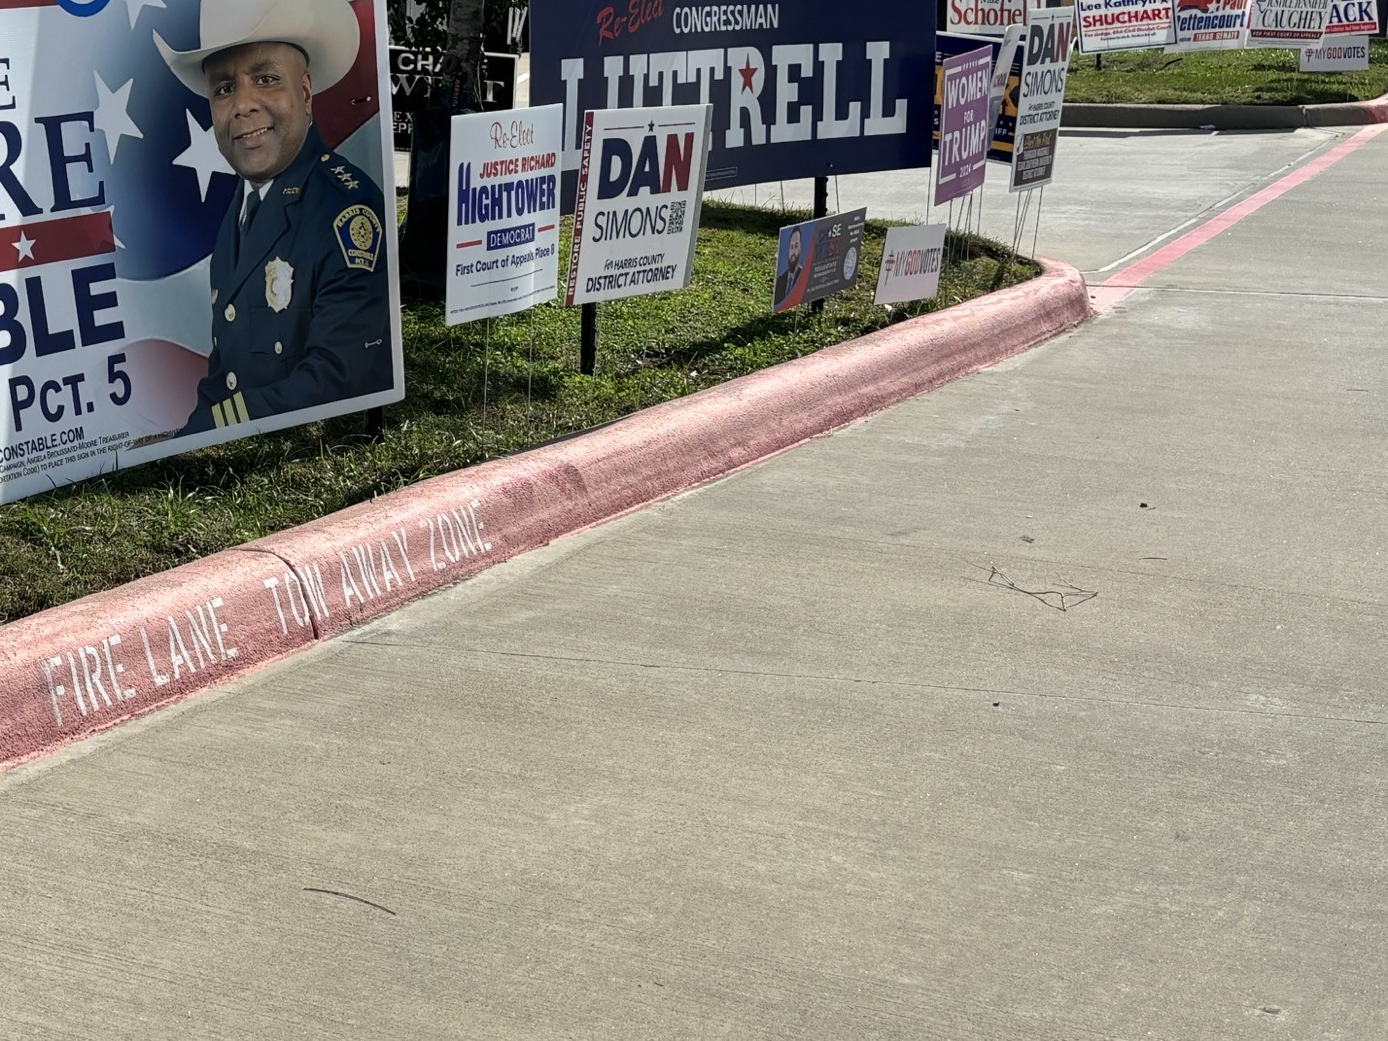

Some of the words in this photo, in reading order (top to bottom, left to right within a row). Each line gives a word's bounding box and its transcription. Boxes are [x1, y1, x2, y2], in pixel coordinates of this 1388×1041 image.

[673, 3, 779, 34] CONGRESSMAN
[1080, 1, 1102, 12] Lee
[1082, 7, 1172, 28] SHUCHART
[1261, 9, 1328, 30] CAUGHEY
[1328, 1, 1375, 24] ACK
[1026, 22, 1071, 67] DAN
[1315, 46, 1366, 59] MYGODVOTES
[948, 68, 989, 109] WOMEN
[1023, 67, 1065, 98] SIMONS
[561, 41, 908, 159] LUTTRELL
[964, 110, 973, 125] FOR
[490, 120, 534, 150] Re-Elect
[944, 119, 987, 167] TRUMP
[480, 158, 518, 180] JUSTICE
[520, 152, 557, 172] RICHARD
[597, 132, 695, 200] DAN
[457, 162, 557, 227] HIGHTOWER
[568, 231, 581, 297] RESTORE
[576, 181, 587, 230] PUBLIC
[582, 124, 593, 177] SAFETY
[592, 204, 669, 243] SIMONS
[490, 226, 534, 248] DEMOCRAT
[455, 262, 474, 277] First
[475, 257, 500, 272] Court
[500, 255, 509, 268] of
[535, 244, 550, 259] Place
[614, 257, 638, 271] HARRIS
[638, 253, 666, 268] COUNTY
[893, 247, 941, 277] MYGODVOTES
[586, 271, 630, 293] DISTRICT
[628, 264, 678, 287] ATTORNEY
[109, 354, 133, 407] 5
[42, 634, 137, 728] FIRE
[140, 596, 239, 687] LANE
[262, 562, 330, 636] TOW
[338, 527, 416, 609] AWAY
[419, 499, 494, 571] ZONE
